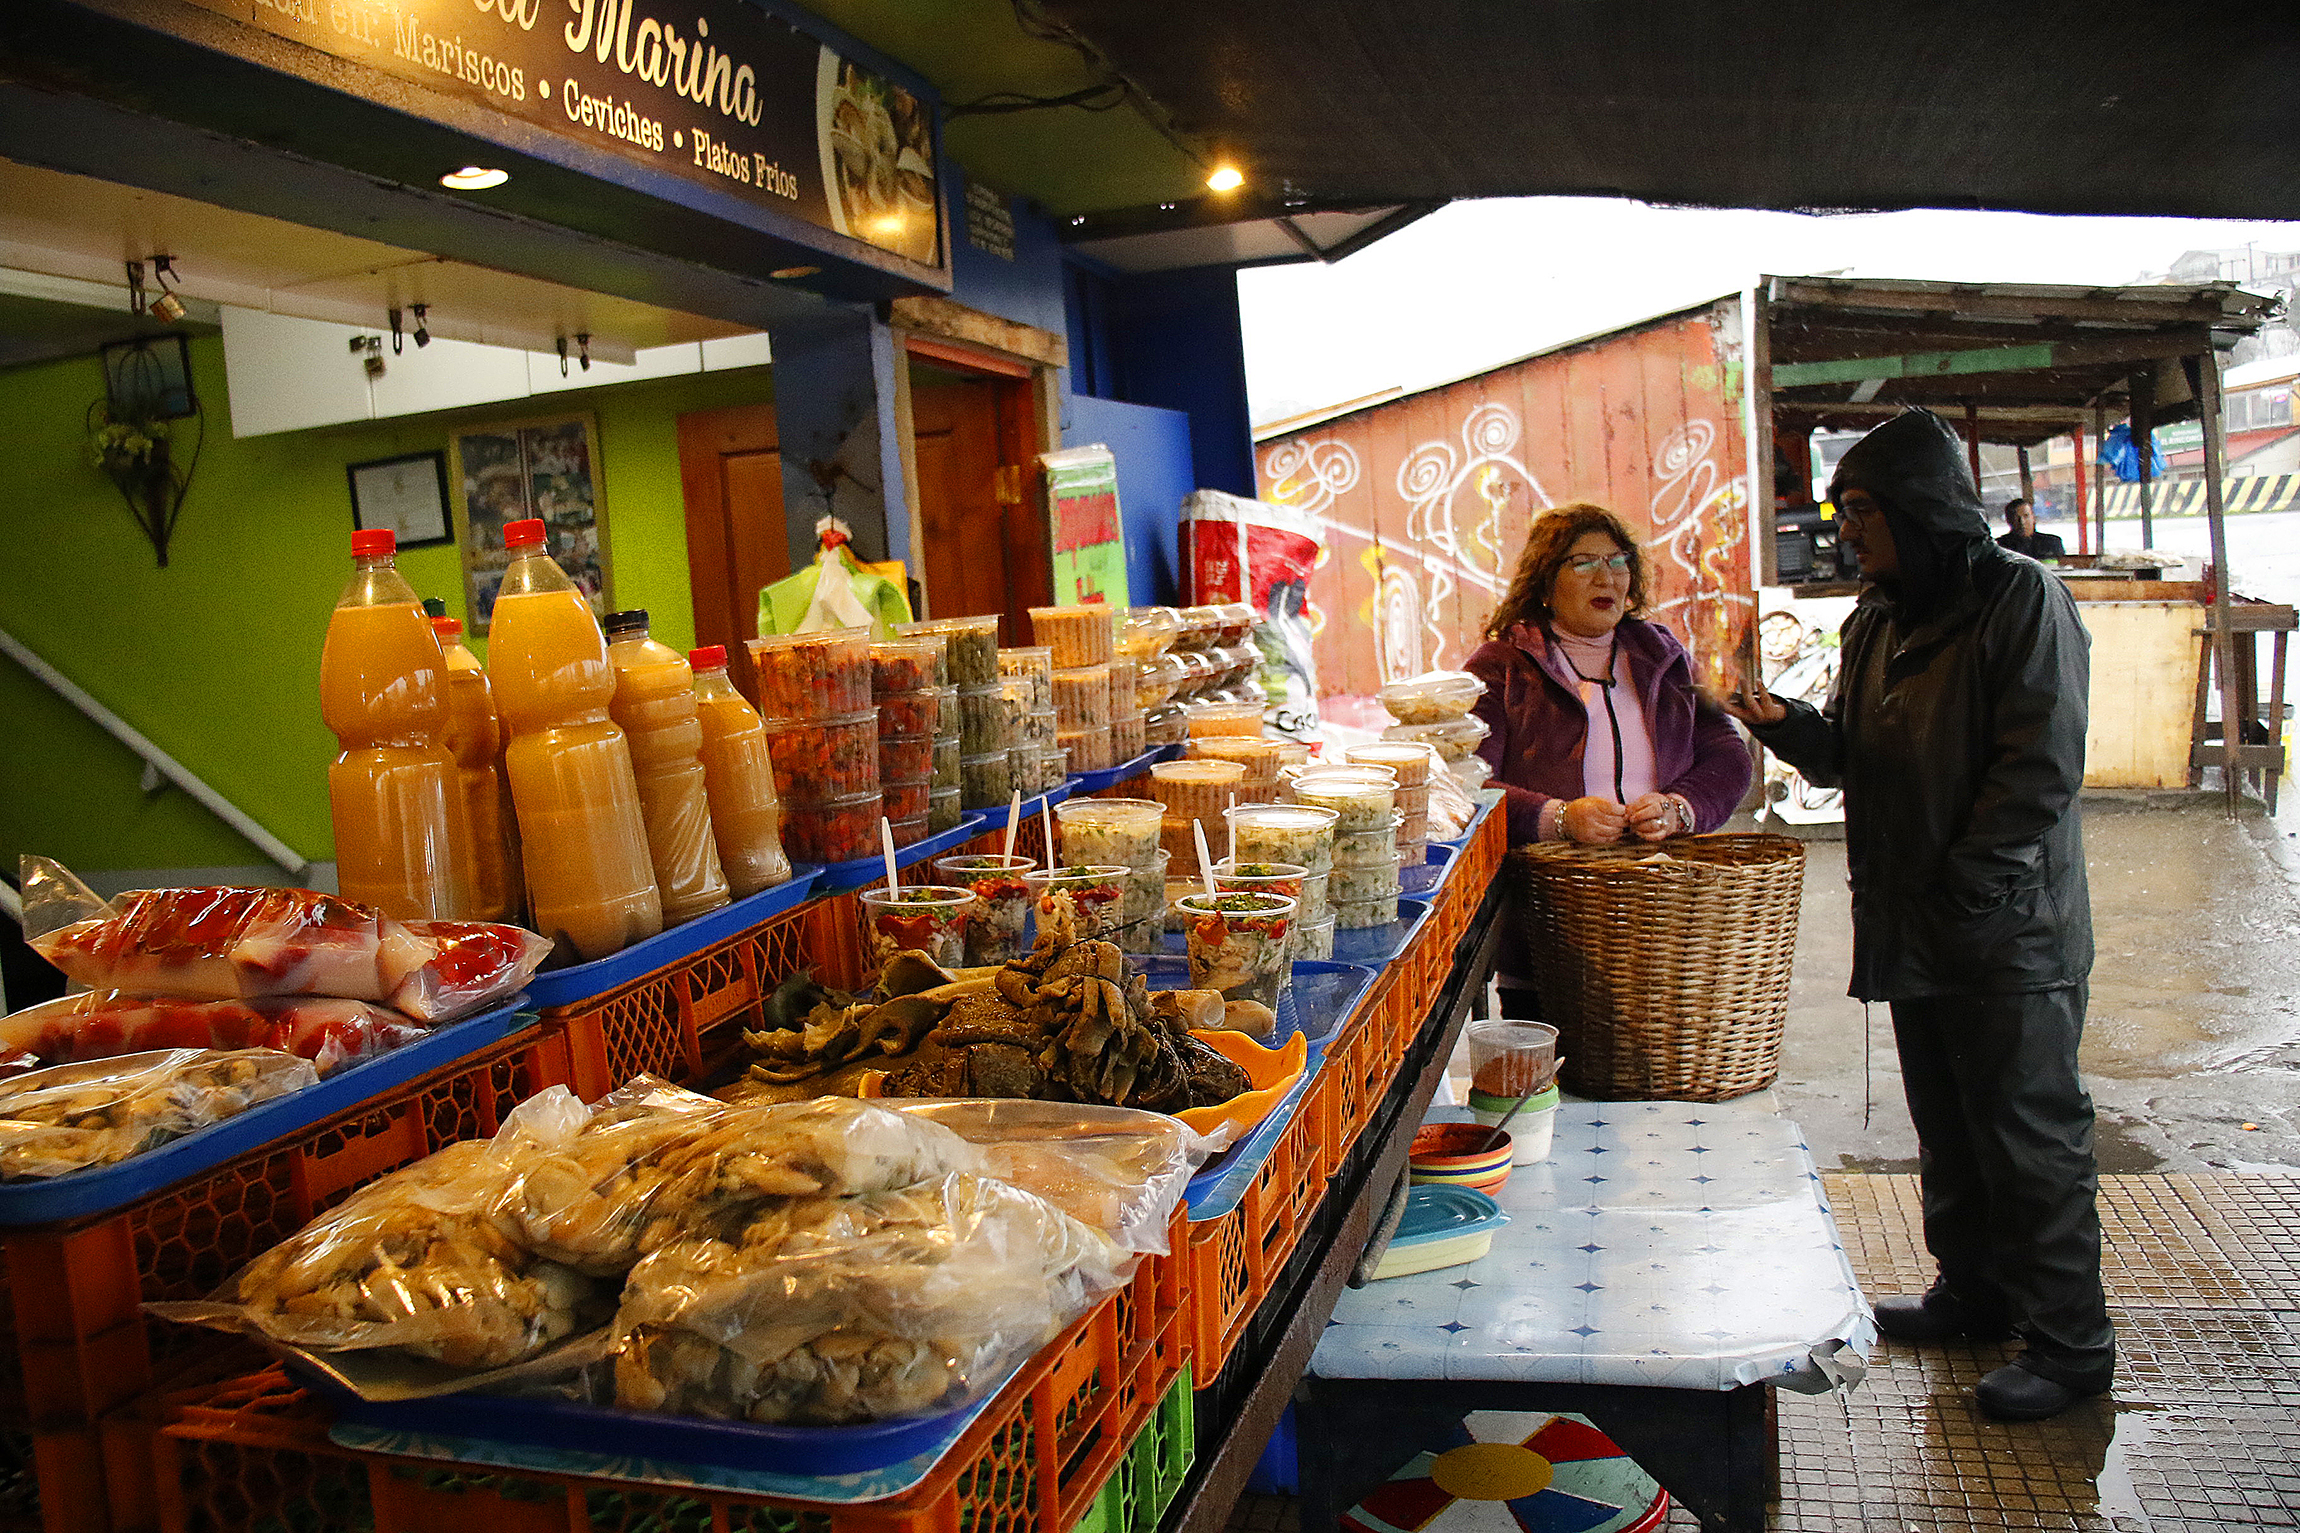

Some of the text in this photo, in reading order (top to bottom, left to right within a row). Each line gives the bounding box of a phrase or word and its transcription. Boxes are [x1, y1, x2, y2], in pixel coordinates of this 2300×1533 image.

[394, 14, 526, 101] Mariscos
[563, 78, 664, 152] Ceviches
[691, 127, 750, 184] Platos
[753, 152, 798, 201] Frios
[564, 0, 763, 127] Marina
